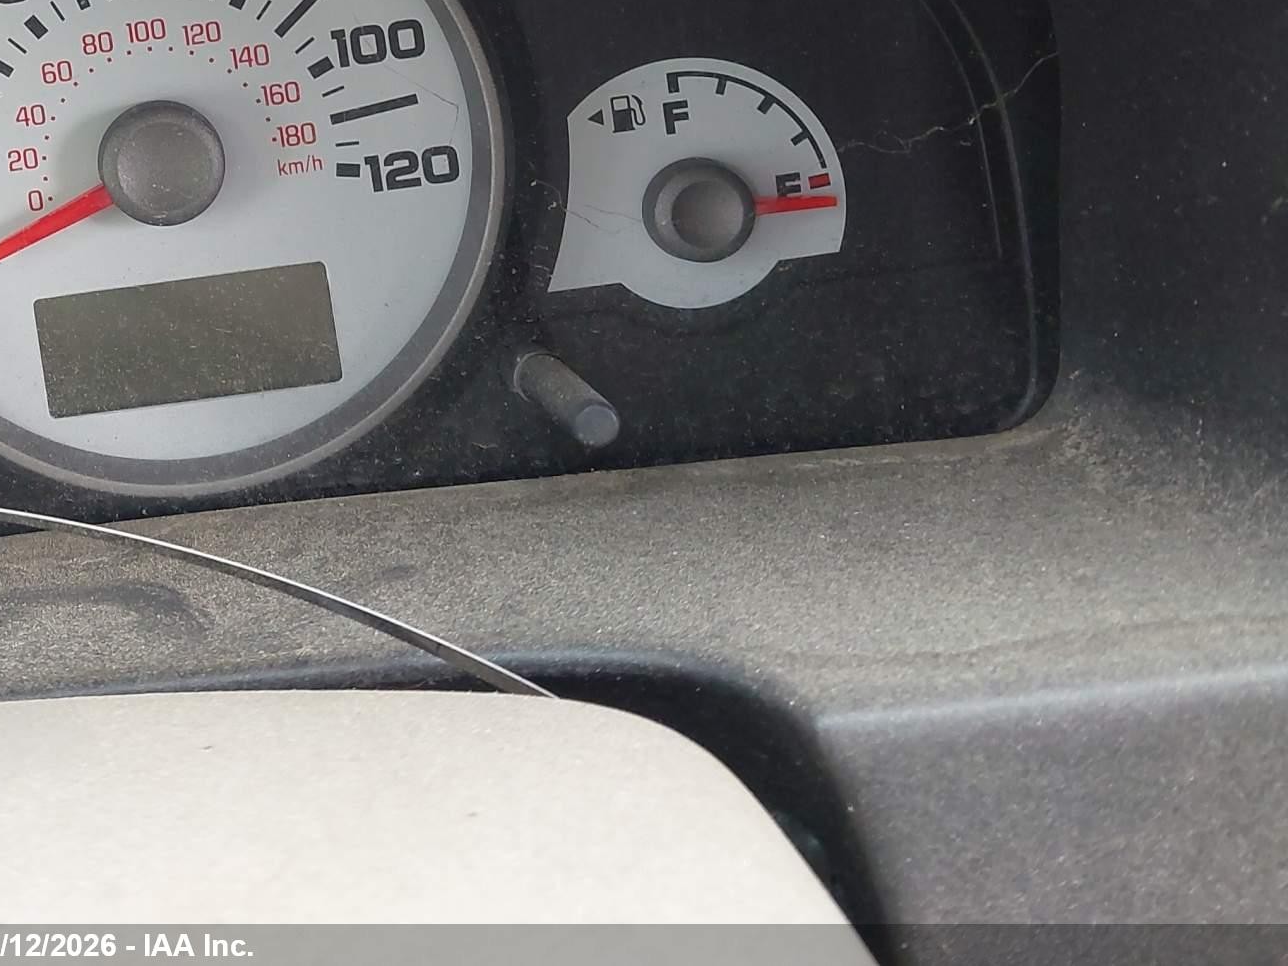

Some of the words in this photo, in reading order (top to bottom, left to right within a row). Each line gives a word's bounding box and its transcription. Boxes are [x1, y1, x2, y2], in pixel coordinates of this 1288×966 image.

[82, 31, 114, 56] 80
[125, 18, 167, 44] 100
[182, 21, 223, 46] 120
[330, 19, 425, 68] 100
[230, 43, 271, 70] 140
[41, 61, 74, 84] 60
[260, 81, 302, 107] 160
[15, 105, 47, 127] 40
[662, 100, 690, 135] F
[277, 123, 318, 148] 180
[7, 148, 39, 173] 20
[277, 154, 324, 177] km/h
[364, 145, 460, 192] 120
[775, 172, 802, 197] E
[27, 189, 46, 212] 0
